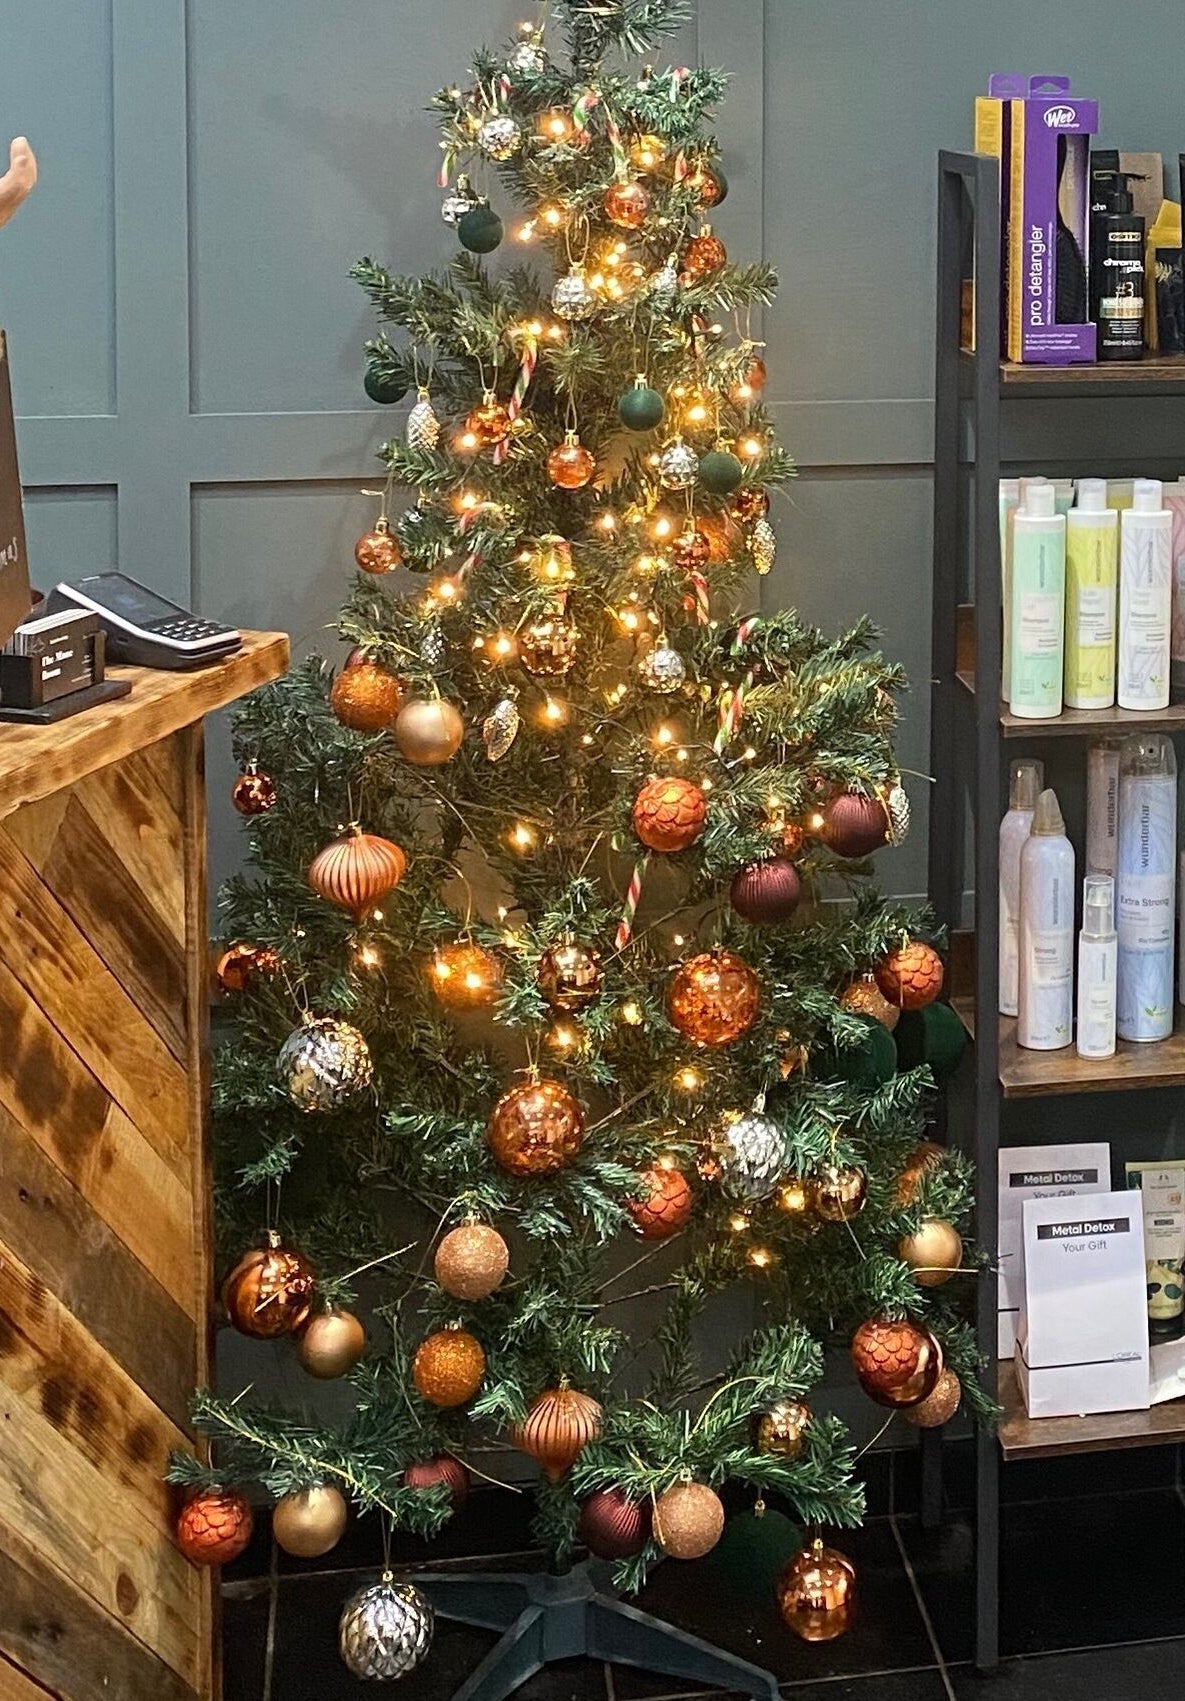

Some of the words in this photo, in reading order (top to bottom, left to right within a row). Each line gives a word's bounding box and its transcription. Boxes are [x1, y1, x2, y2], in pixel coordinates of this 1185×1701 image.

[1046, 109, 1073, 128] Wet
[1028, 224, 1046, 296] detangler
[1030, 300, 1045, 326] pro
[1141, 804, 1150, 868] wunderbar
[1023, 1172, 1053, 1184] Metal
[1054, 1172, 1085, 1183] Detox
[1052, 1223, 1083, 1236] Metal
[1084, 1221, 1116, 1233] Detox
[1062, 1242, 1086, 1253] Your
[1087, 1240, 1108, 1250] Gift
